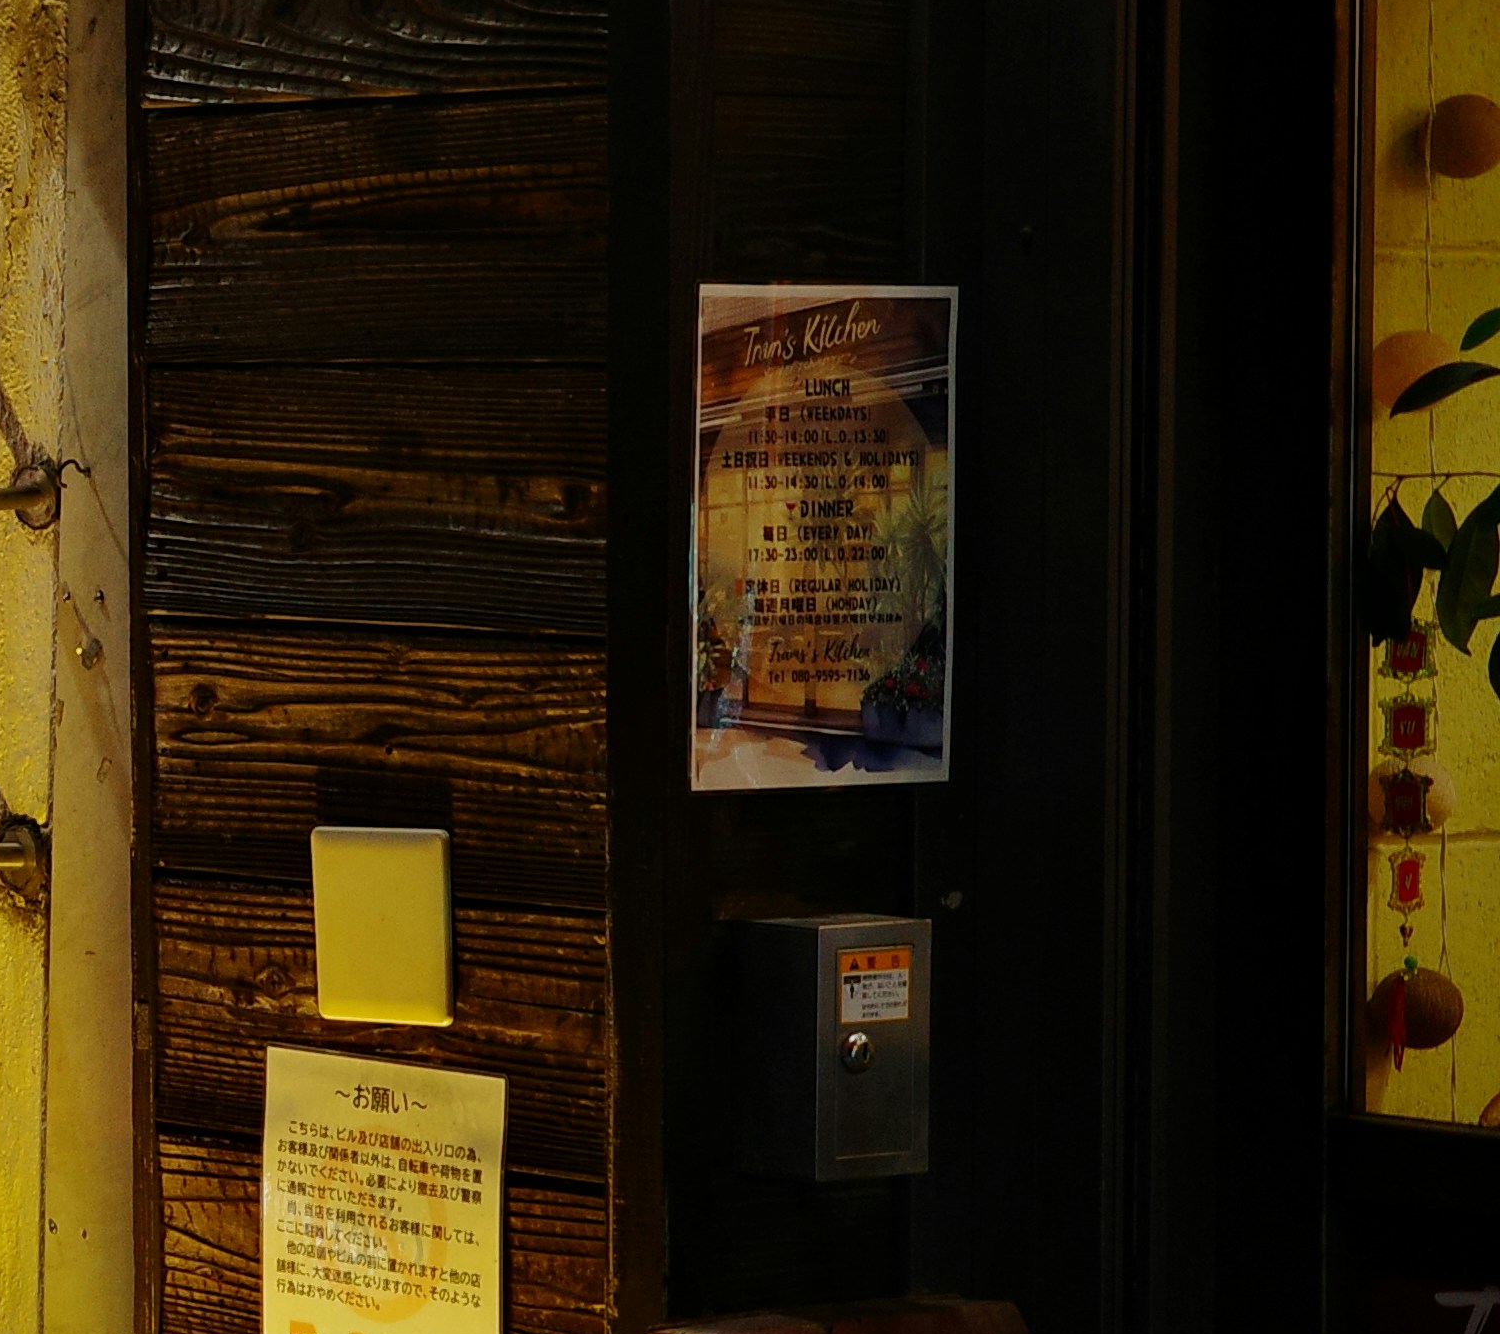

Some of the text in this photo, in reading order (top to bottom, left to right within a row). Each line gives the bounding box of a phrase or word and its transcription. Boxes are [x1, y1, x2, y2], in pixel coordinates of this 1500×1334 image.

[802, 300, 880, 355] Kitchen
[805, 379, 849, 395] LUNCH
[765, 405, 871, 422] 平日 (WEEKDAYS)
[859, 449, 918, 466] HOLIDAYS)
[800, 499, 853, 517] DINNER
[763, 524, 872, 541] 毎日 (EVERY DAY)
[789, 577, 841, 593] (REGULAR
[848, 575, 900, 592] HOLIDAY)
[825, 595, 877, 612] (MONDAY)
[768, 670, 784, 683] Tel
